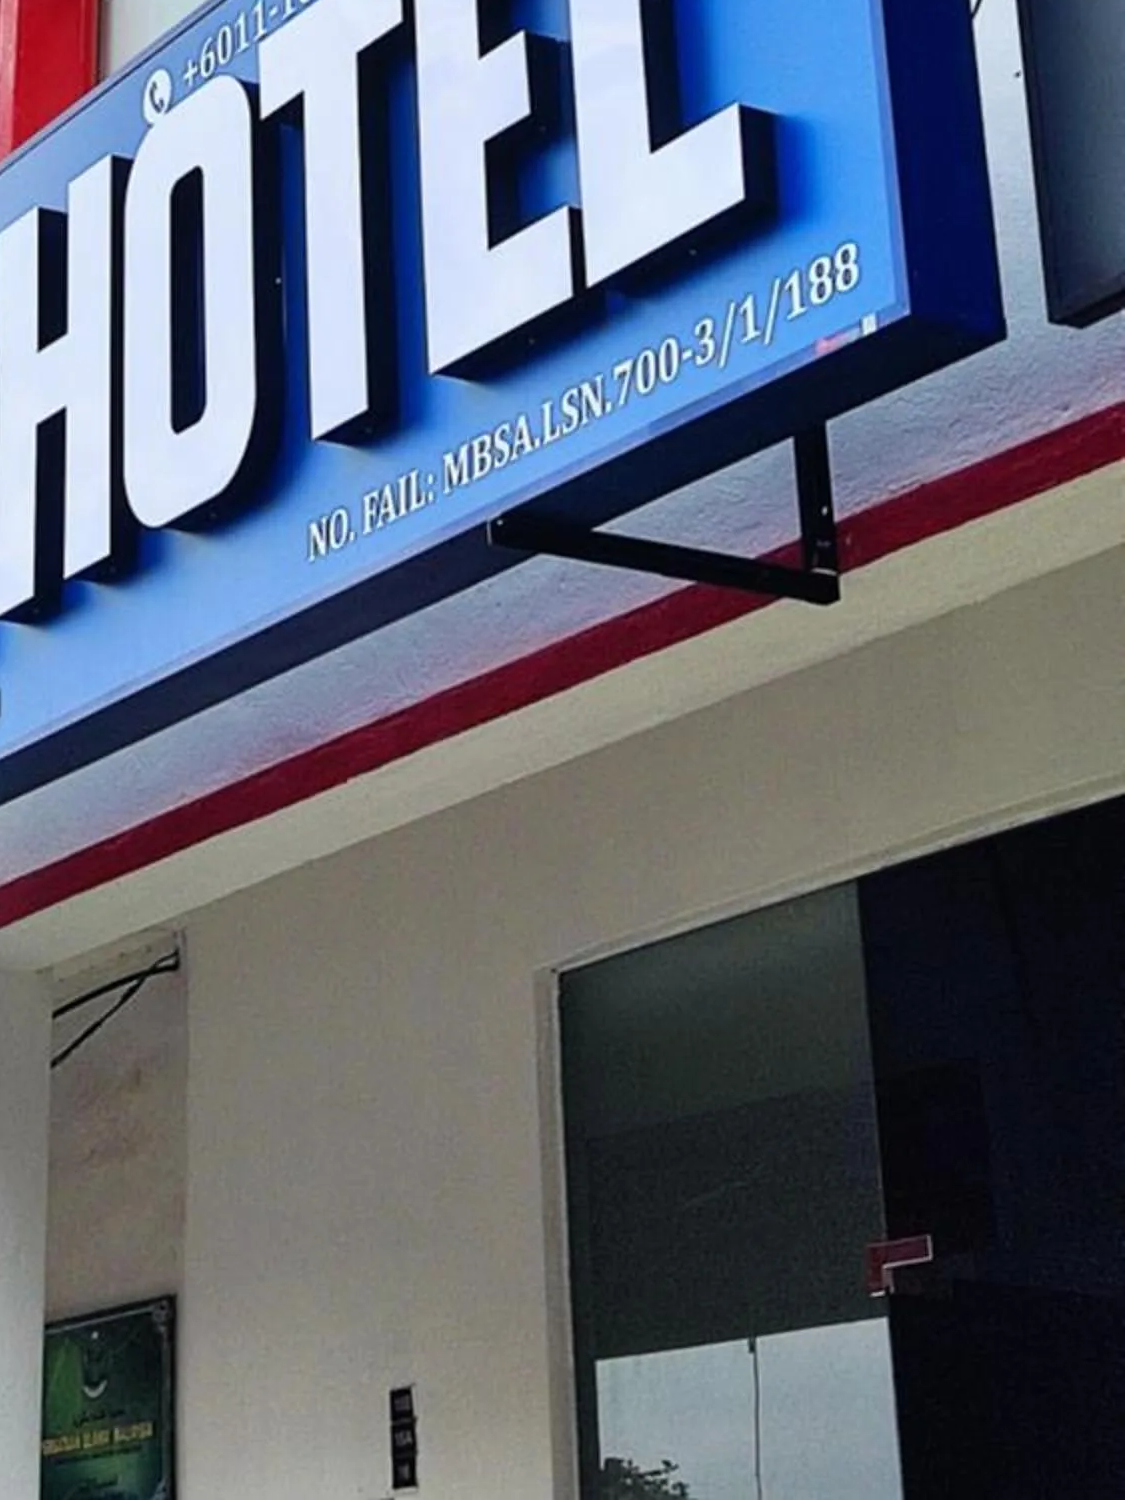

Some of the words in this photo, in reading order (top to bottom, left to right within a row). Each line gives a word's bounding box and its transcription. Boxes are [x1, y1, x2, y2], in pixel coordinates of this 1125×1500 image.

[305, 508, 357, 563] NO.
[362, 469, 436, 540] FAIL:
[442, 241, 861, 498] MBSA.LSN.700-3/1/188
